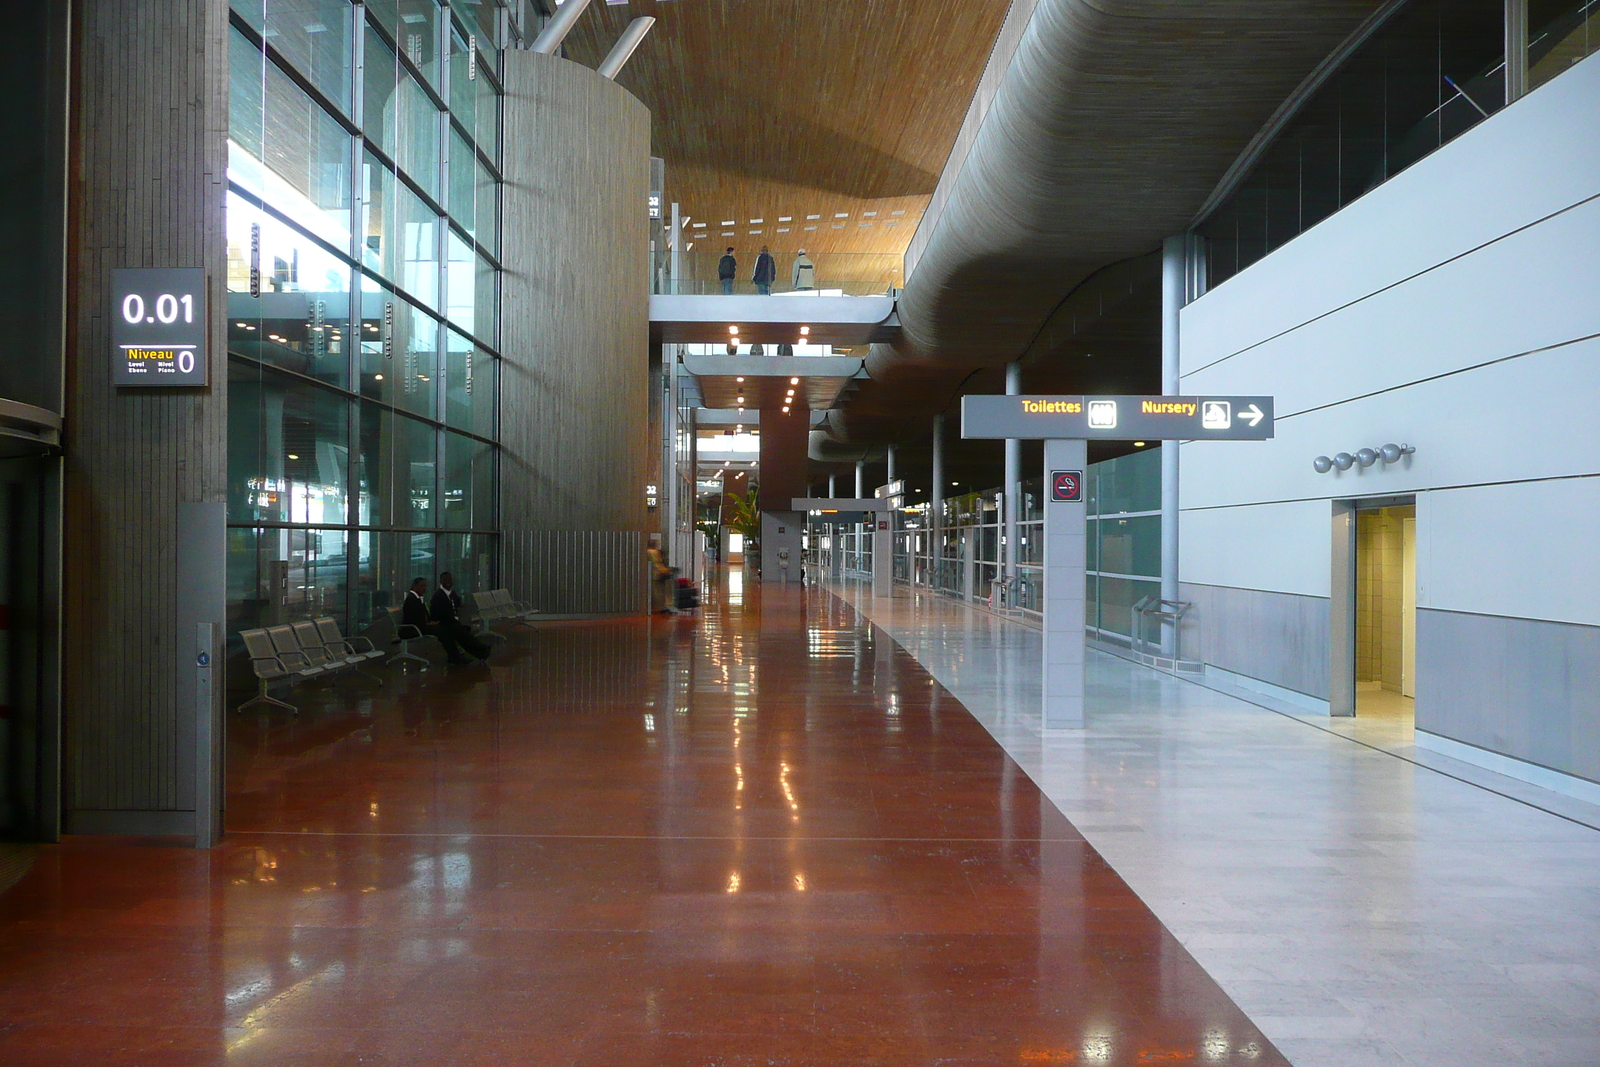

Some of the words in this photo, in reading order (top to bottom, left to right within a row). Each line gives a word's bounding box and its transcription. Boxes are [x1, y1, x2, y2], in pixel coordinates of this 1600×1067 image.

[122, 293, 193, 324] 0.01
[127, 348, 174, 360] Niveau
[178, 350, 195, 374] 0
[1021, 400, 1082, 413] Toilettes
[1141, 400, 1197, 416] Nursery
